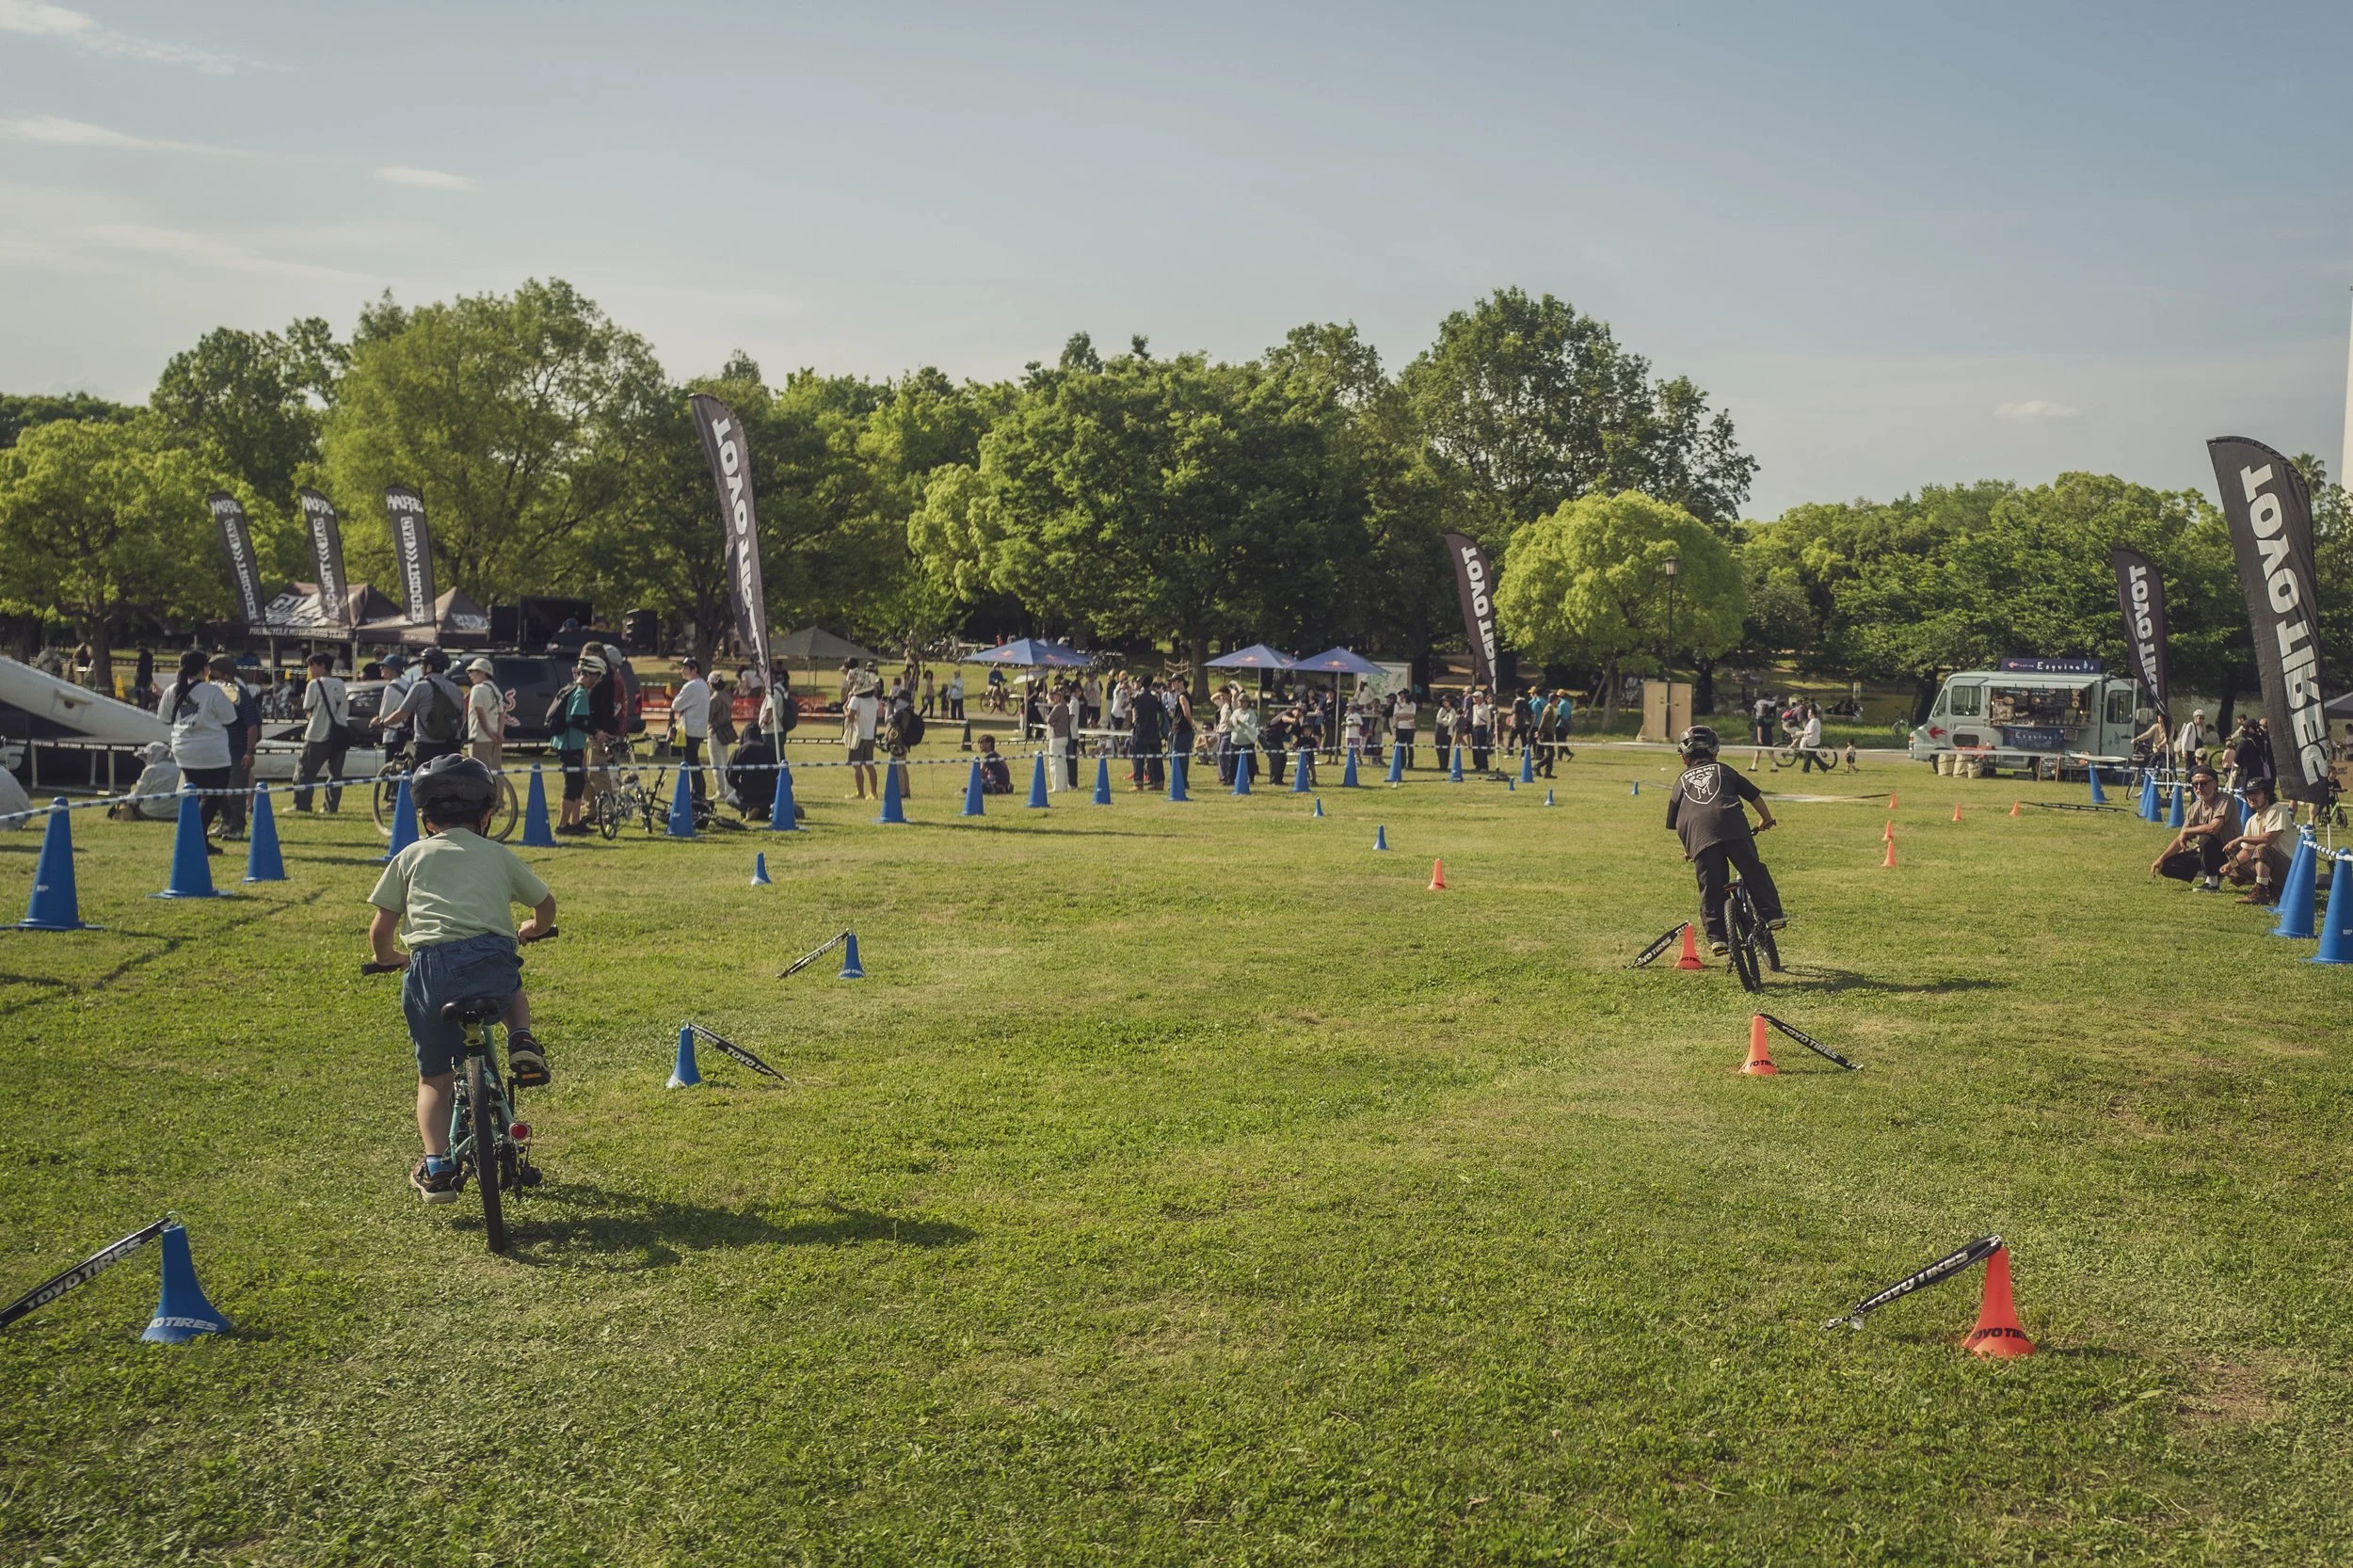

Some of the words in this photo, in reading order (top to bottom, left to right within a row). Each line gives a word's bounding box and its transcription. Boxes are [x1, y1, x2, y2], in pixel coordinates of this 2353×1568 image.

[1685, 766, 1715, 779] MIAMI
[727, 1047, 757, 1067] TOYO
[1807, 1039, 1837, 1060] TIRES
[24, 1272, 81, 1310] TOYO
[80, 1237, 141, 1279] TIRES
[1867, 1277, 1914, 1306] TOYO
[166, 1317, 218, 1332] TIRES
